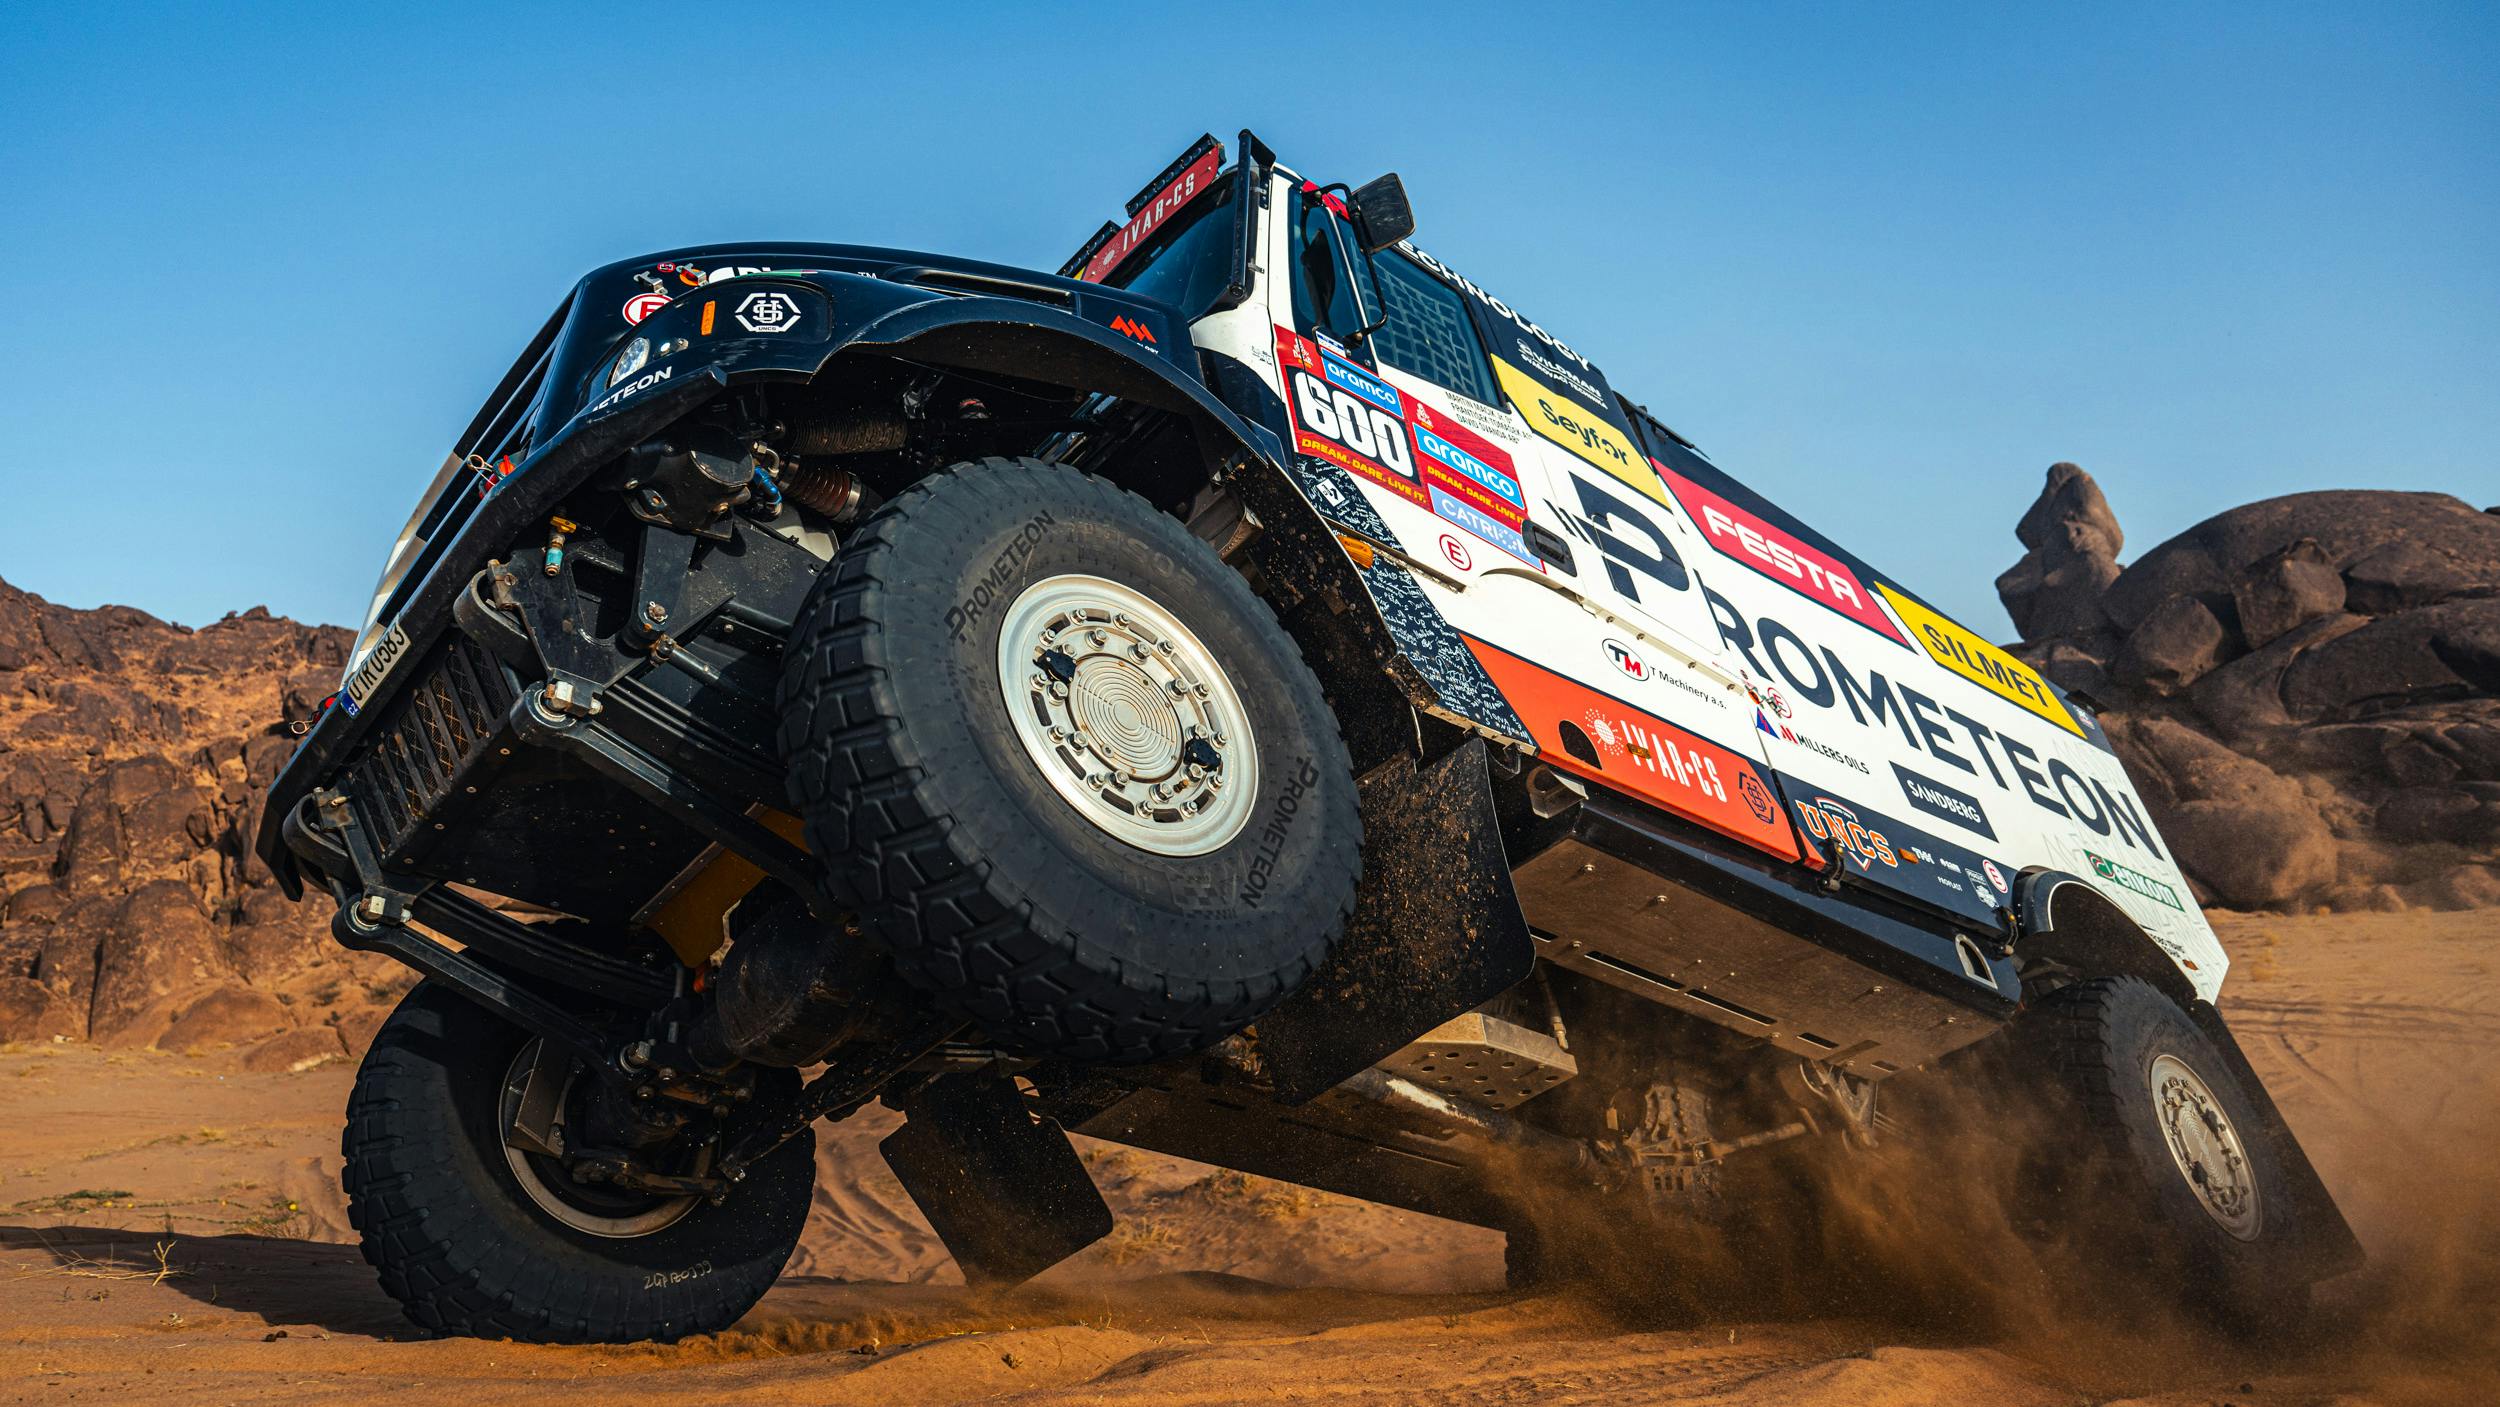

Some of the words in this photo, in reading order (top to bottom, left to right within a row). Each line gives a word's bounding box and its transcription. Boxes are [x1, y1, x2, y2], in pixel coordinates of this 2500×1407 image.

[1399, 239, 1590, 371] ECHNOLOGY
[1328, 362, 1396, 405] aramco
[1294, 371, 1414, 478] 600
[1538, 399, 1629, 466] Seyfor
[1302, 438, 1351, 465] DREAM.
[1352, 459, 1386, 483] DARE.
[1387, 477, 1412, 496] LIVE
[1413, 488, 1427, 504] IT.
[1423, 435, 1515, 497] aramco
[1427, 465, 1466, 493] DREAM.
[1466, 487, 1495, 509] DARE.
[1495, 502, 1517, 522] LIVE
[943, 509, 1056, 645] PROMETEON
[1447, 540, 1465, 565] E
[1702, 504, 1863, 610] FESTA
[1568, 470, 2165, 862] PROMETEON
[1607, 642, 1643, 678] TM
[1650, 666, 1657, 677] T
[1658, 671, 1710, 703] Machinery
[1710, 695, 1728, 710] a.s.
[1922, 623, 2049, 708] SILMET
[347, 702, 359, 716] CZ
[1795, 732, 1844, 764] MILLERS
[1844, 754, 1871, 775] OILS
[1240, 755, 1320, 909] PROMETEON
[1795, 799, 1899, 868] UNCS
[1906, 779, 1982, 824] SANDBERG
